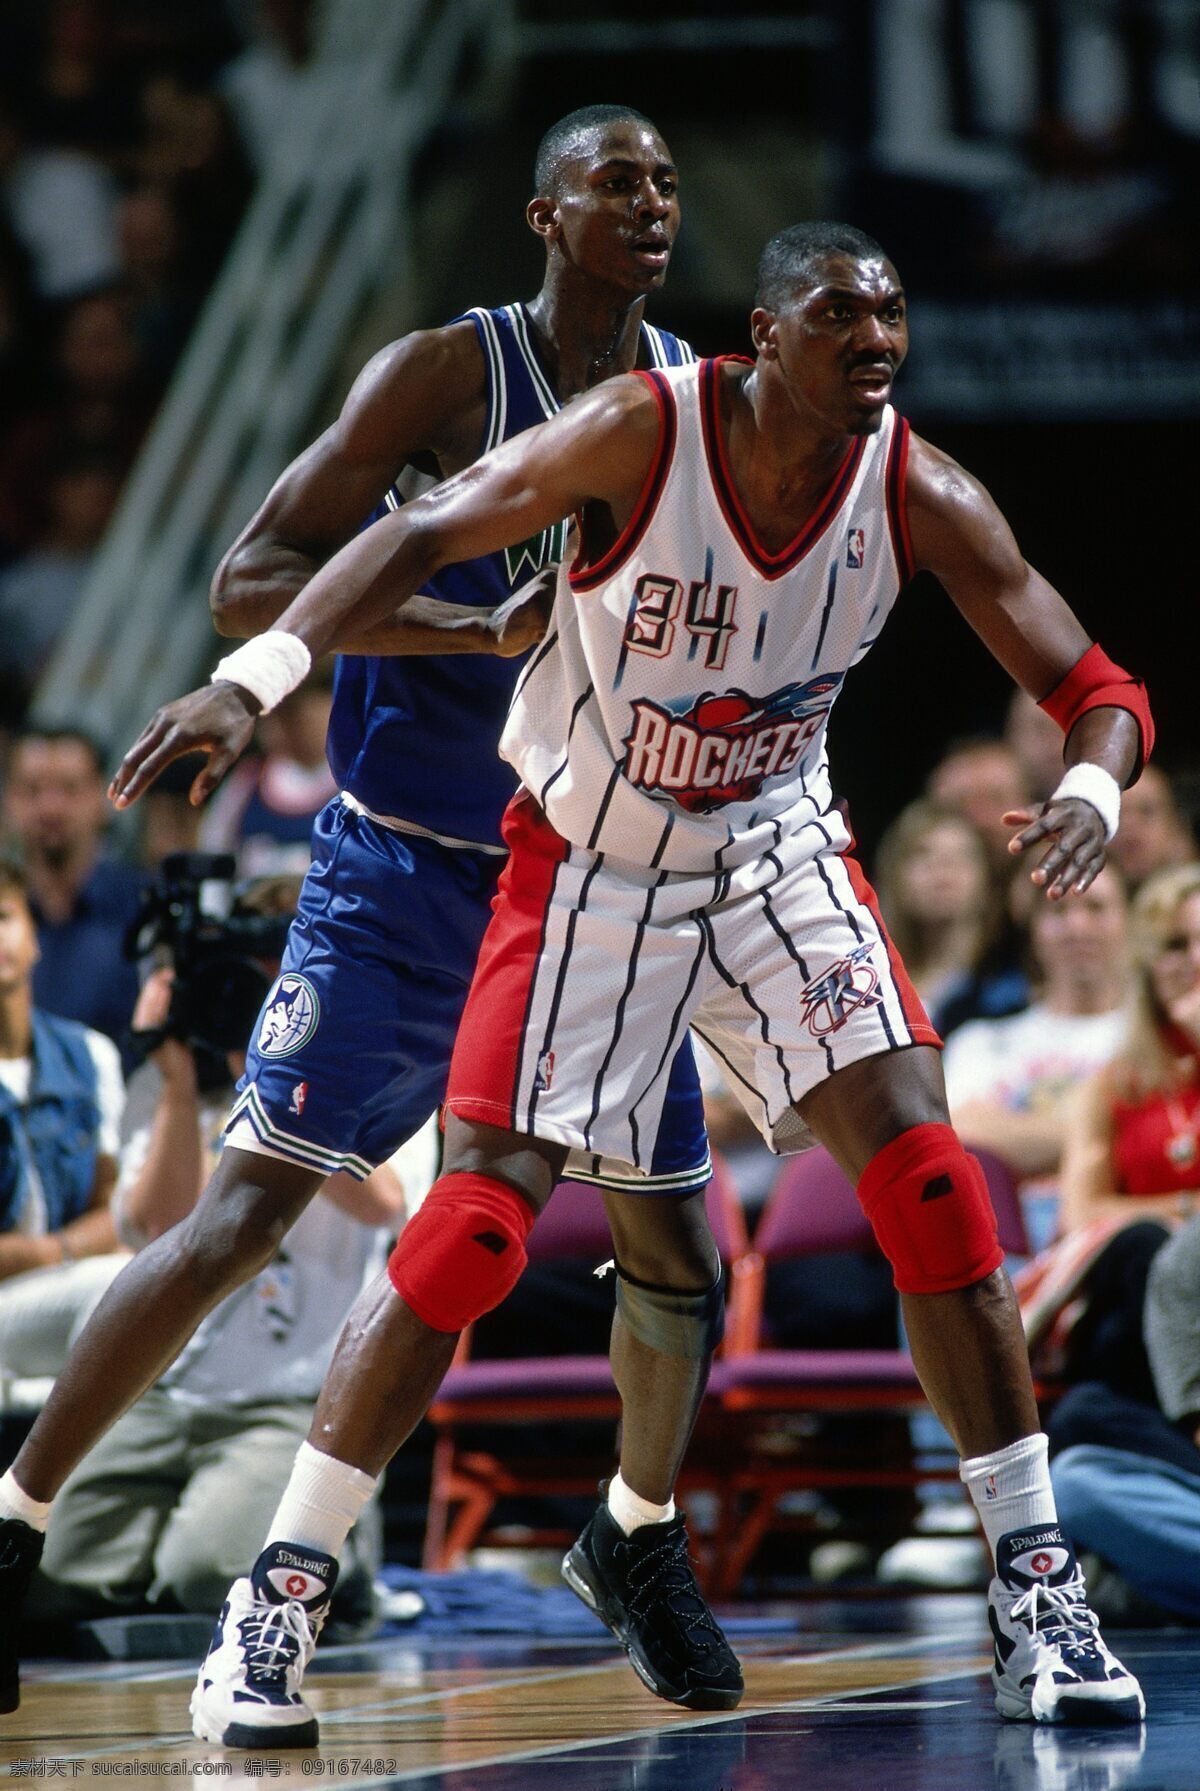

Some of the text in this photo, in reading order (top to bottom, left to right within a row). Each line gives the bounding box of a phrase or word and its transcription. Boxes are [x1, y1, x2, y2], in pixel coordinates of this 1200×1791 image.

[626, 573, 738, 671] 34
[624, 704, 829, 790] ROCKETS
[276, 1550, 330, 1577] SPALDING
[1010, 1529, 1061, 1552] SPALDING
